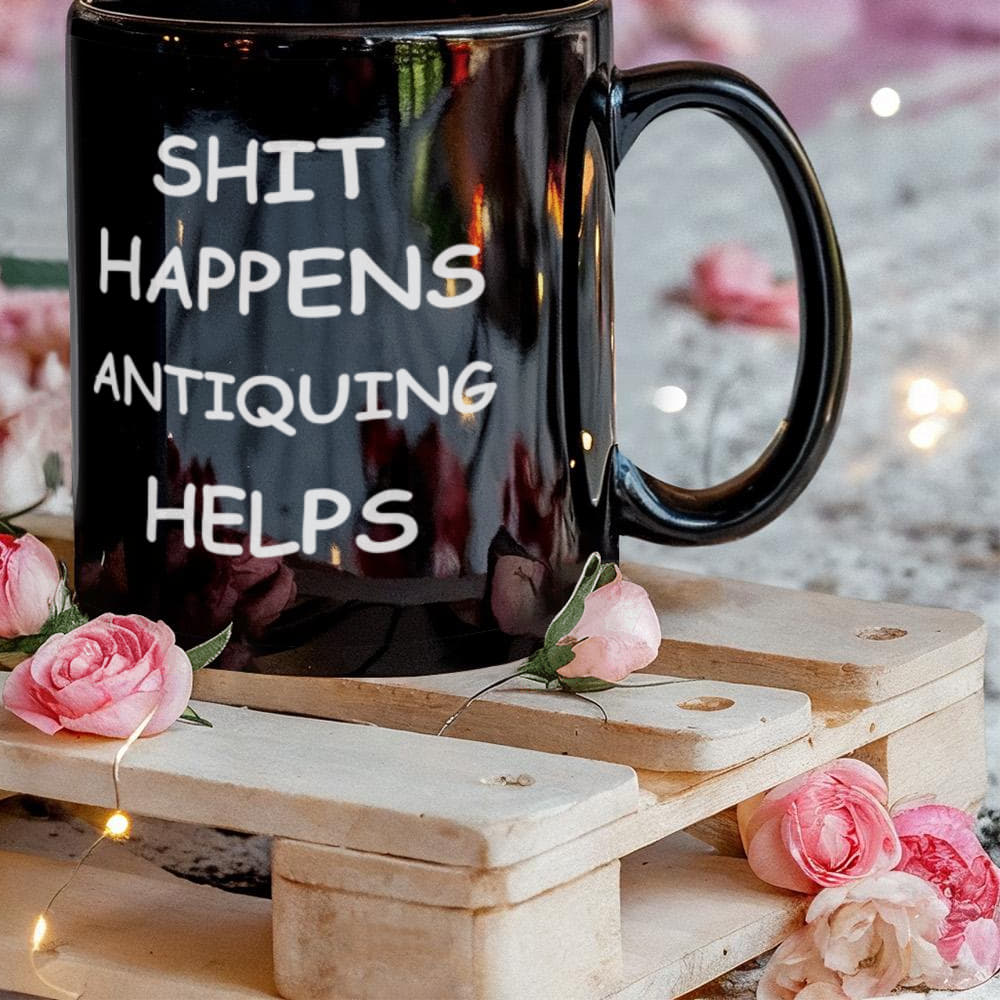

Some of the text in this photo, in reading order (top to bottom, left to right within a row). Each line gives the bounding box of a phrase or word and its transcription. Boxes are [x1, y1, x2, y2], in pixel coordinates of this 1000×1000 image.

[153, 134, 386, 205] SHIT
[99, 226, 486, 319] HAPPENS
[93, 351, 498, 437] ANTIQUING
[146, 476, 419, 559] HELPS
